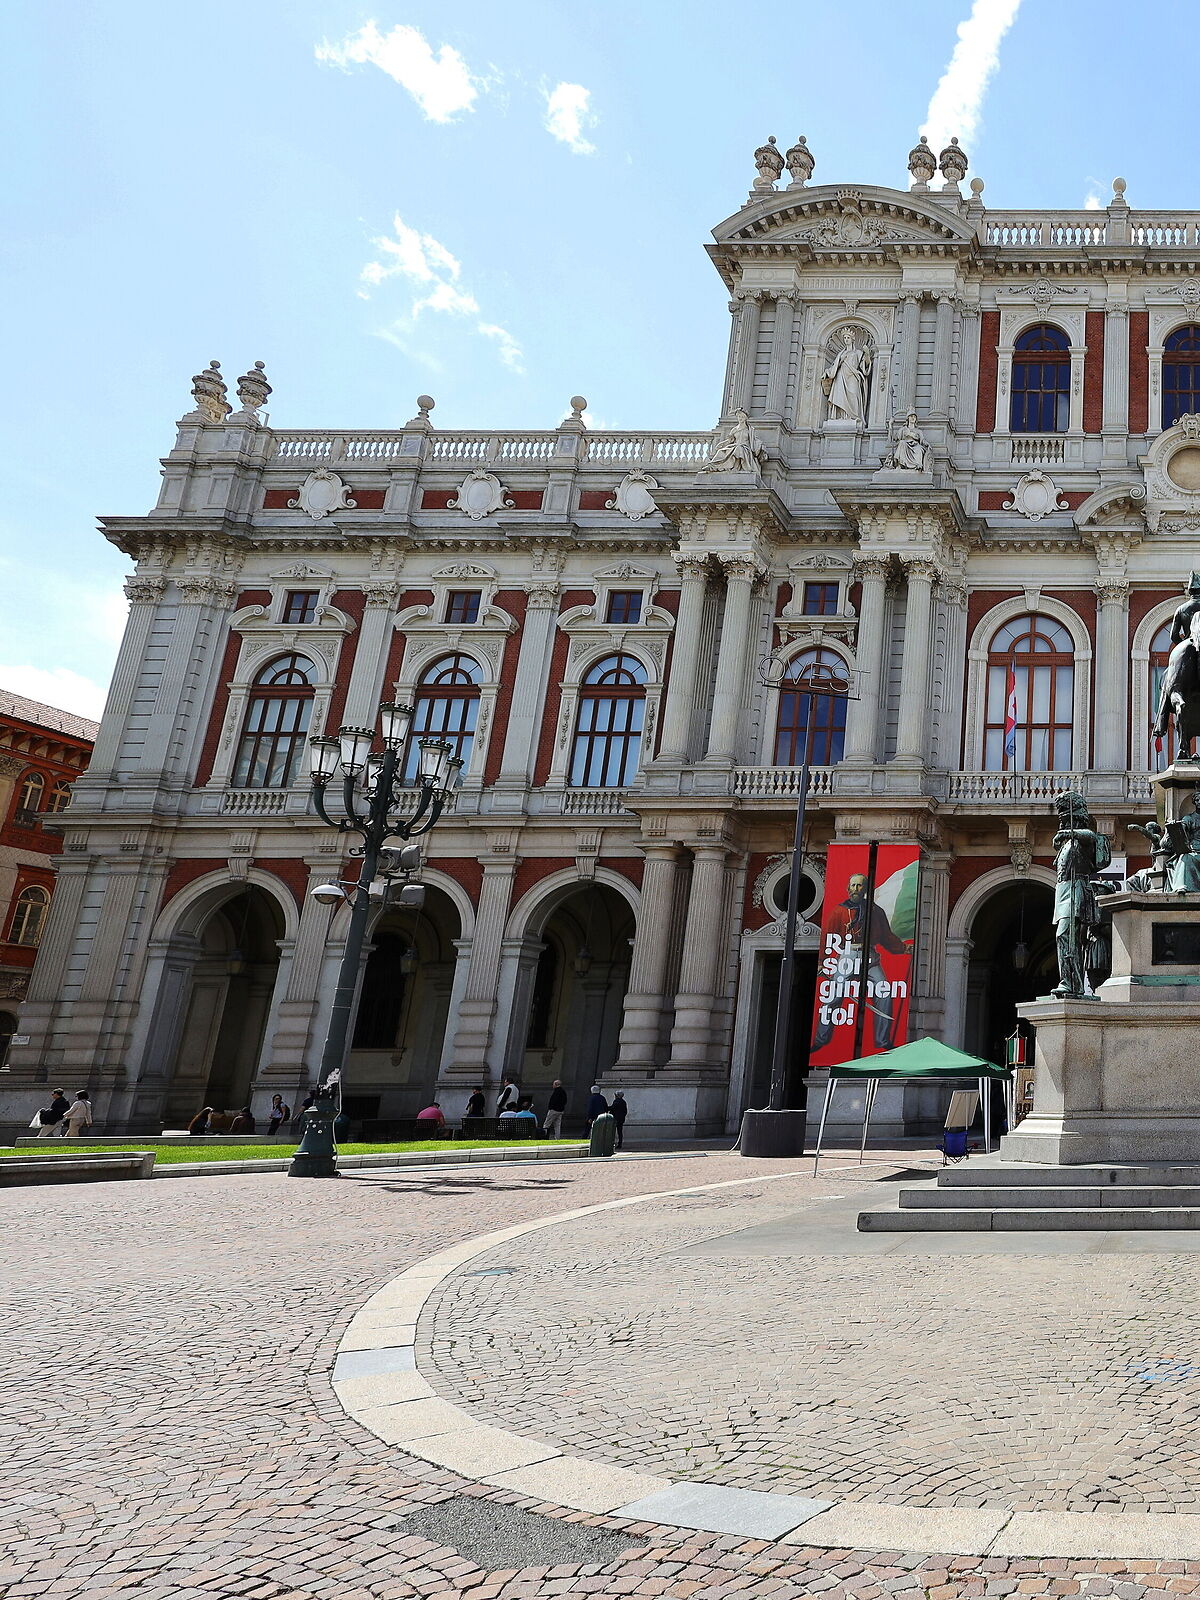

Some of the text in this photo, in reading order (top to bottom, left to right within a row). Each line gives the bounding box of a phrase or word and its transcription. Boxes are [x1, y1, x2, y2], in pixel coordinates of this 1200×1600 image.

[759, 656, 871, 697] OVEST
[825, 933, 852, 955] Ri
[819, 1004, 855, 1026] to!
